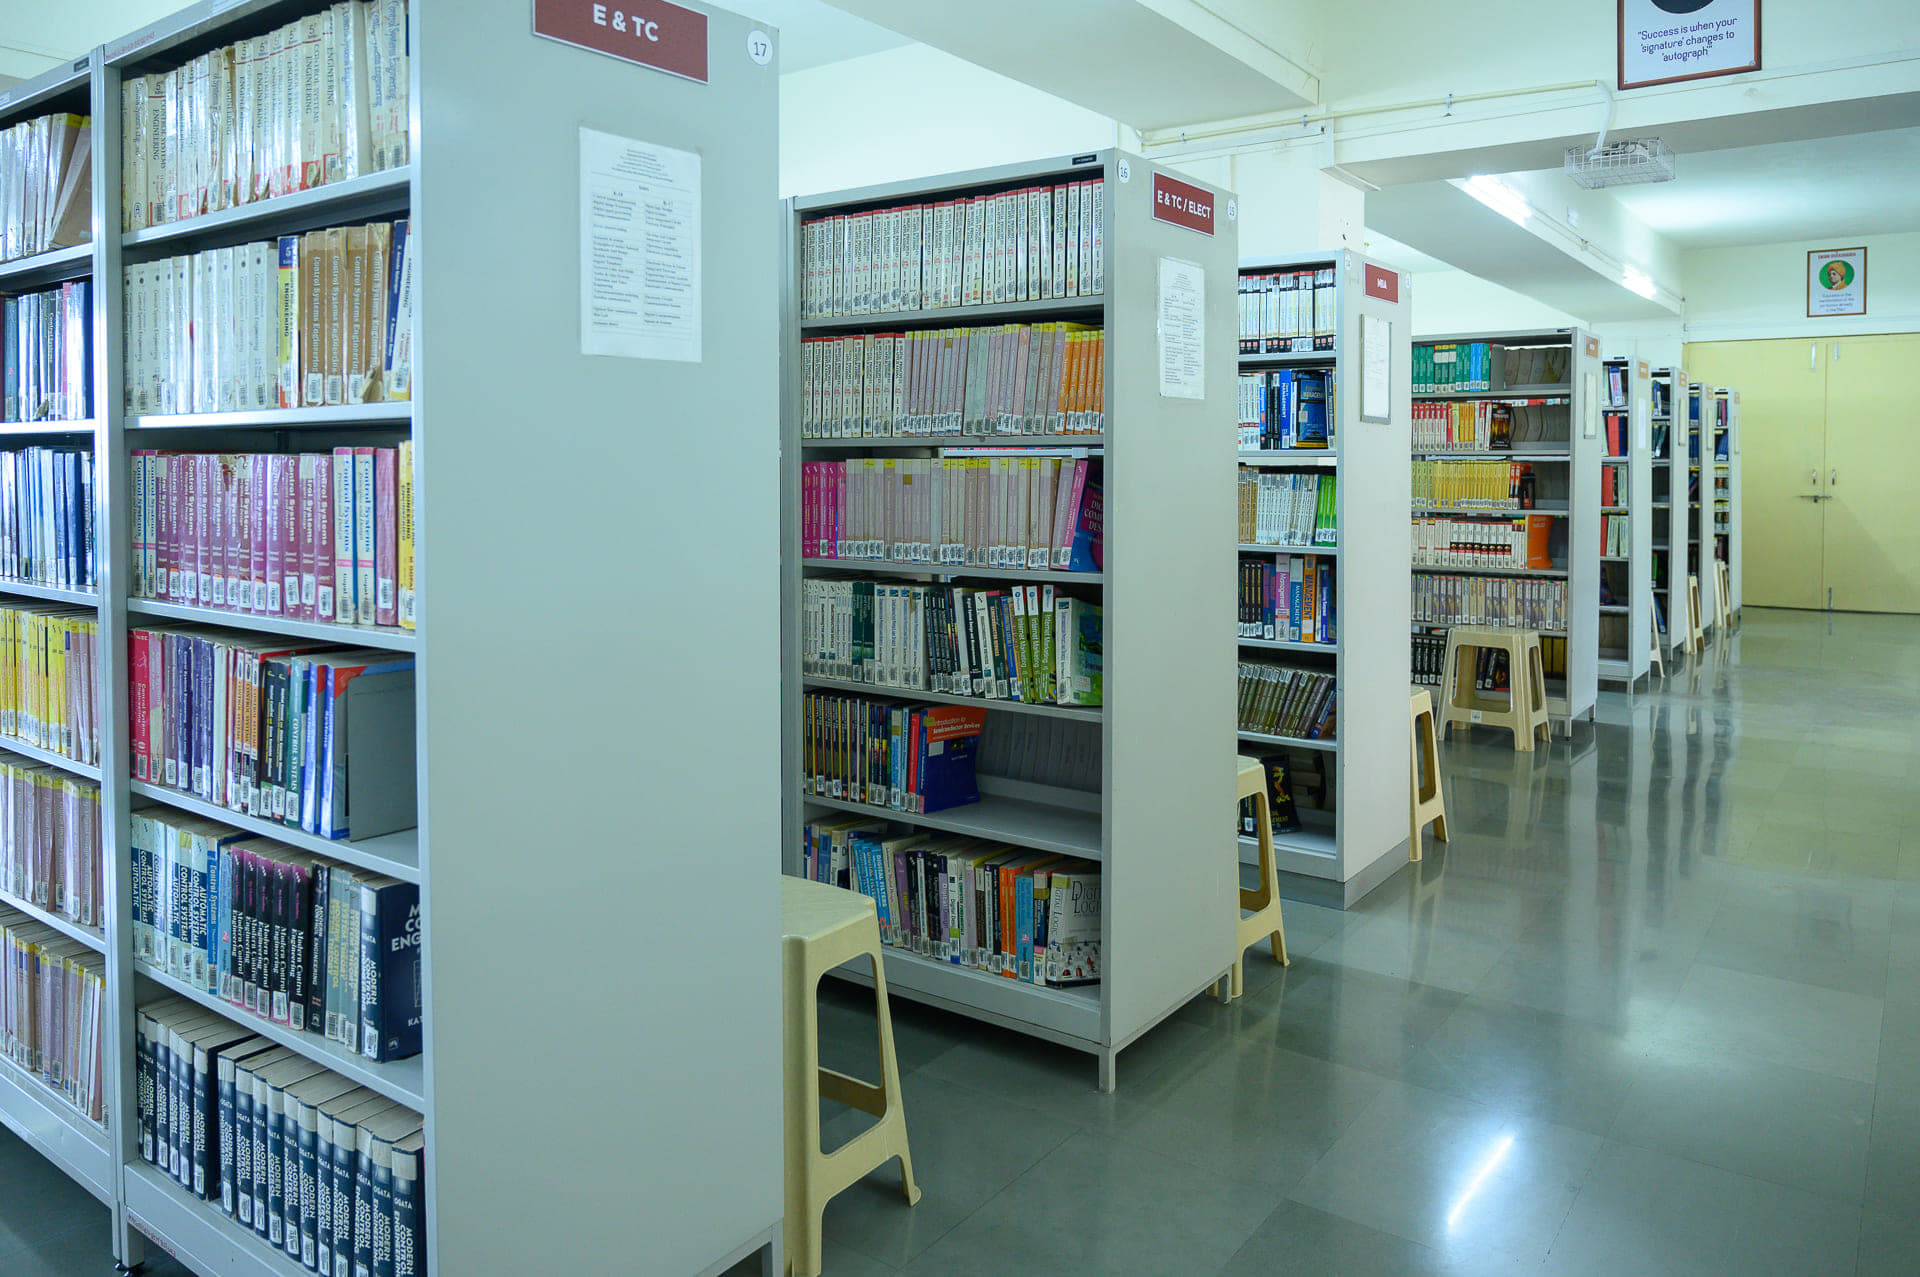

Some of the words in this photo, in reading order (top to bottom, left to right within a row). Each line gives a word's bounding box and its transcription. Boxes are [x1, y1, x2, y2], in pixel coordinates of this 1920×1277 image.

[593, 3, 607, 26] E
[612, 11, 626, 32] &
[632, 16, 659, 42] TC
[1638, 28, 1679, 40] "Success
[1689, 22, 1713, 32] when
[1716, 17, 1737, 30] your
[753, 41, 767, 57] 17
[1640, 37, 1684, 54] 'signature'
[1686, 34, 1723, 44] changes
[1726, 31, 1734, 39] to
[305, 56, 313, 114] ENGINEERING
[1121, 167, 1127, 178] 16
[1172, 195, 1181, 209] TC
[1189, 201, 1211, 219] ELECT
[332, 256, 340, 286] Control
[373, 251, 381, 281] Control
[312, 288, 320, 321] Systems
[331, 288, 339, 321] Systems
[353, 289, 361, 322] Systems
[372, 284, 380, 317] Systems
[343, 460, 351, 504] Control
[364, 460, 372, 504] Control
[256, 496, 264, 541] Systems
[343, 509, 351, 552] Systems
[1278, 573, 1286, 608] Management
[1304, 574, 1313, 620] MANAGEMENT
[934, 718, 960, 727] ntroduction
[132, 861, 140, 908] AUTOMATIC
[180, 867, 188, 903] CONTROL
[876, 854, 885, 880] DIGITAL
[141, 887, 149, 924] SYSTEMS
[172, 875, 180, 924] AUTOMATIC
[192, 870, 200, 908] CONTROL
[879, 882, 887, 907] FILTERS
[1074, 893, 1101, 914] LOGI
[181, 904, 189, 943] SYSTEMS
[199, 885, 207, 936] AUTOMATIC
[210, 894, 218, 924] Systems
[192, 909, 200, 946] SYSTEMS
[231, 910, 239, 957] Engineering
[244, 916, 252, 964] Engineering
[256, 921, 264, 970] Engineering
[273, 924, 281, 974] Engineering
[289, 928, 298, 977] Engineering
[296, 930, 304, 962] Modern
[334, 1166, 350, 1178] OGATA
[357, 1173, 372, 1186] OGATA
[373, 1187, 391, 1198] OGATA
[394, 1197, 413, 1210] OGATA
[383, 1216, 391, 1262] MODERN
[399, 1224, 407, 1277] CONTROL
[405, 1228, 413, 1276] MODERN
